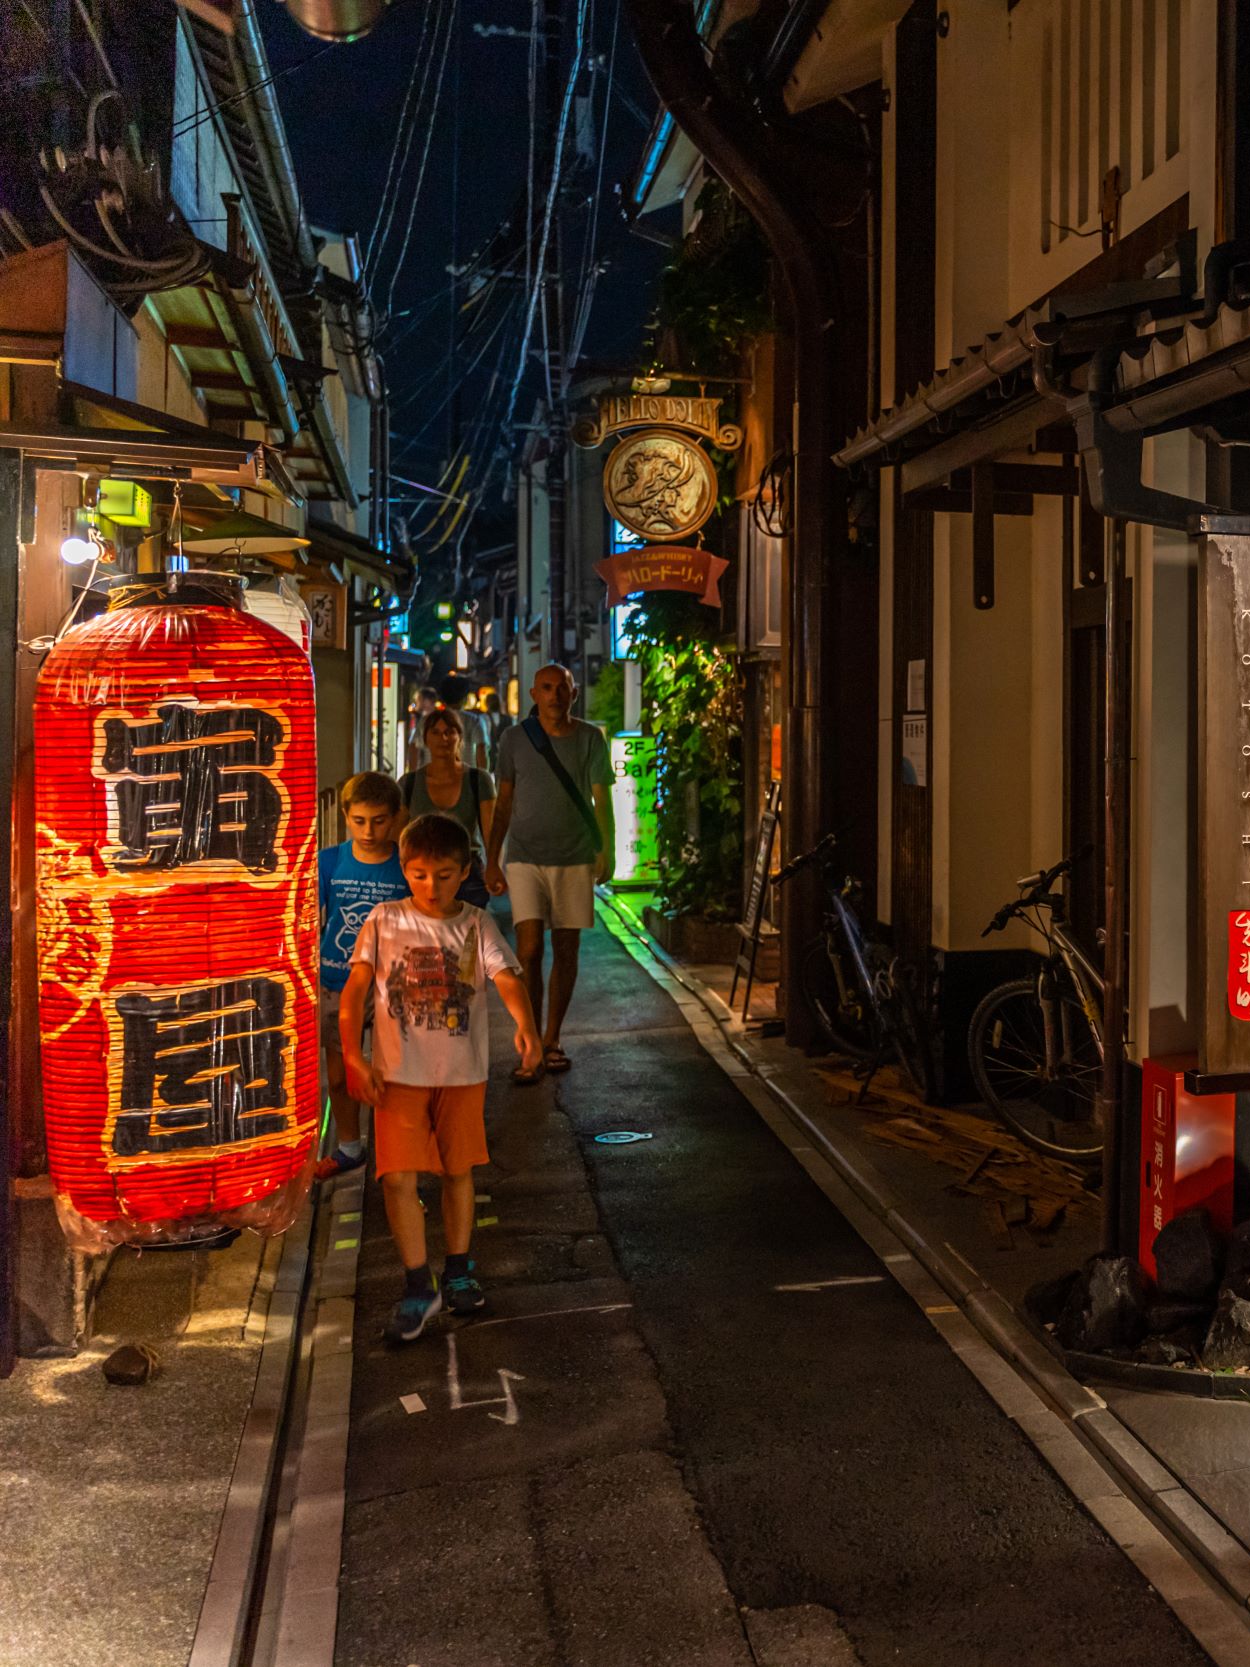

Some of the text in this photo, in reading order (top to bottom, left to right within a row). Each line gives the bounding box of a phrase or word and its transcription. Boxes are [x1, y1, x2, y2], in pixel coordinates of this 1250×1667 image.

[624, 741, 645, 755] 2F
[360, 880, 376, 888] who
[378, 881, 396, 889] loves
[1153, 1139, 1164, 1232] 消火器
